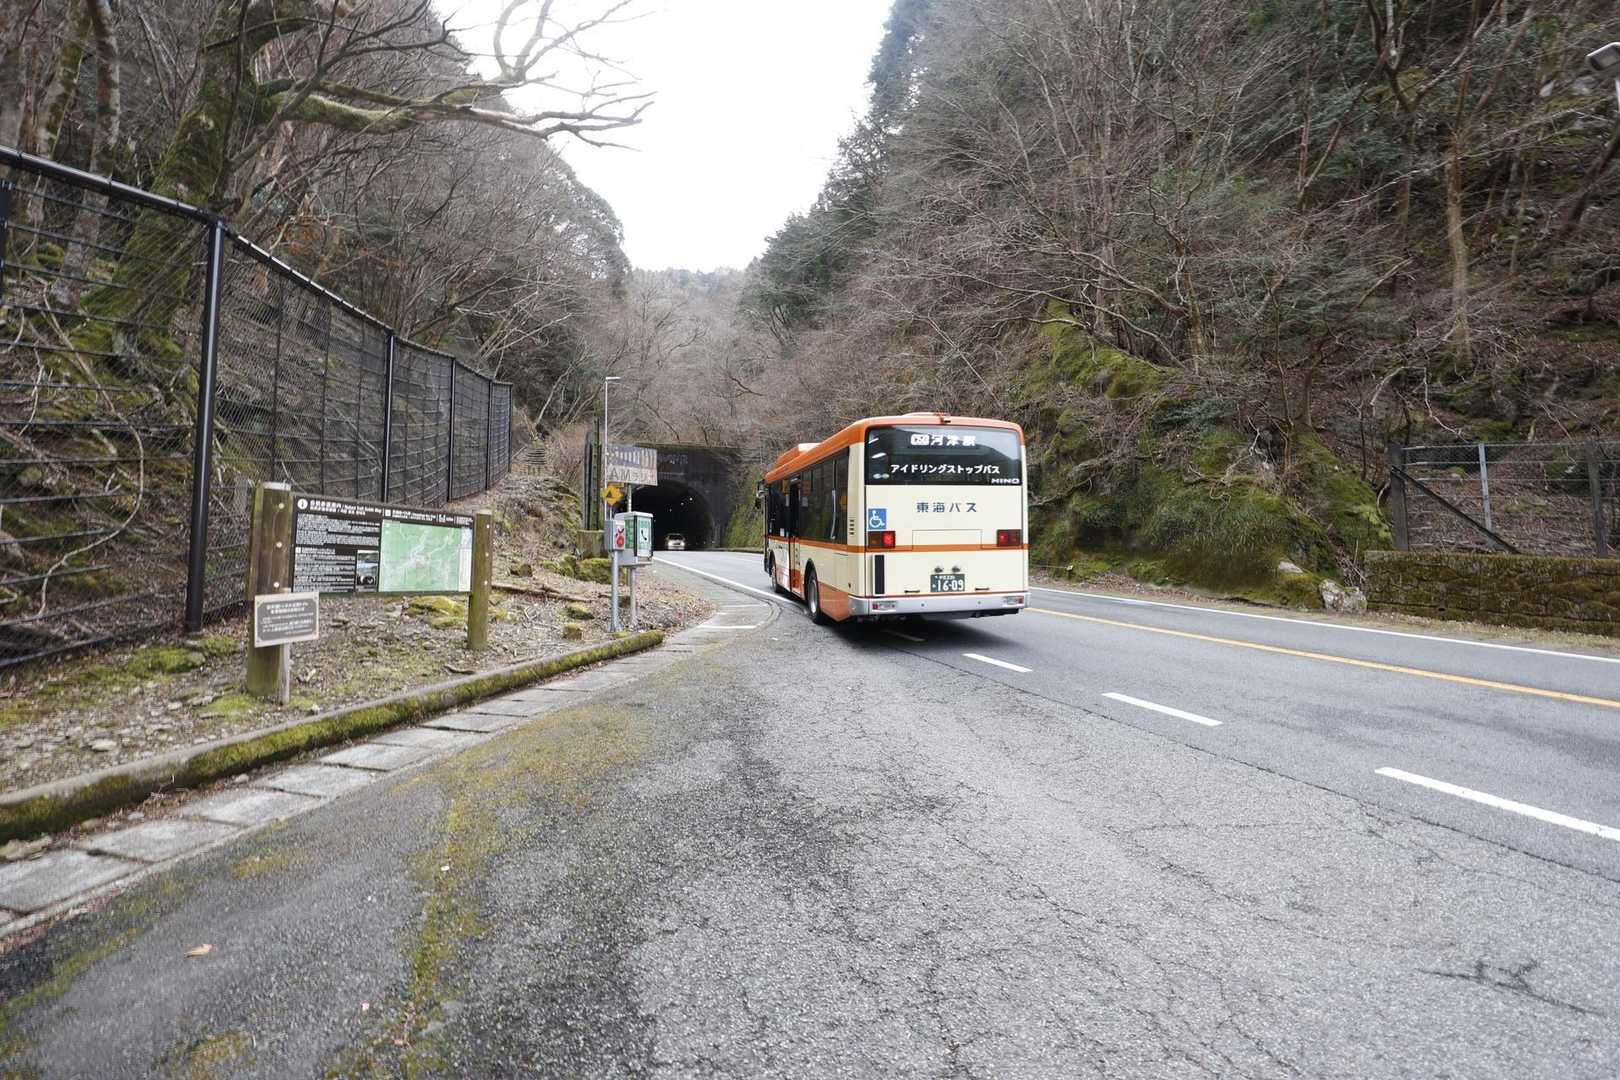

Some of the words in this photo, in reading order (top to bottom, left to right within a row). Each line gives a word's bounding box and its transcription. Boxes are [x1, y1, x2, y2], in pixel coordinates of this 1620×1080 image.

[890, 464, 1000, 474] アイドリングストップバス
[916, 502, 977, 513] 東海バス
